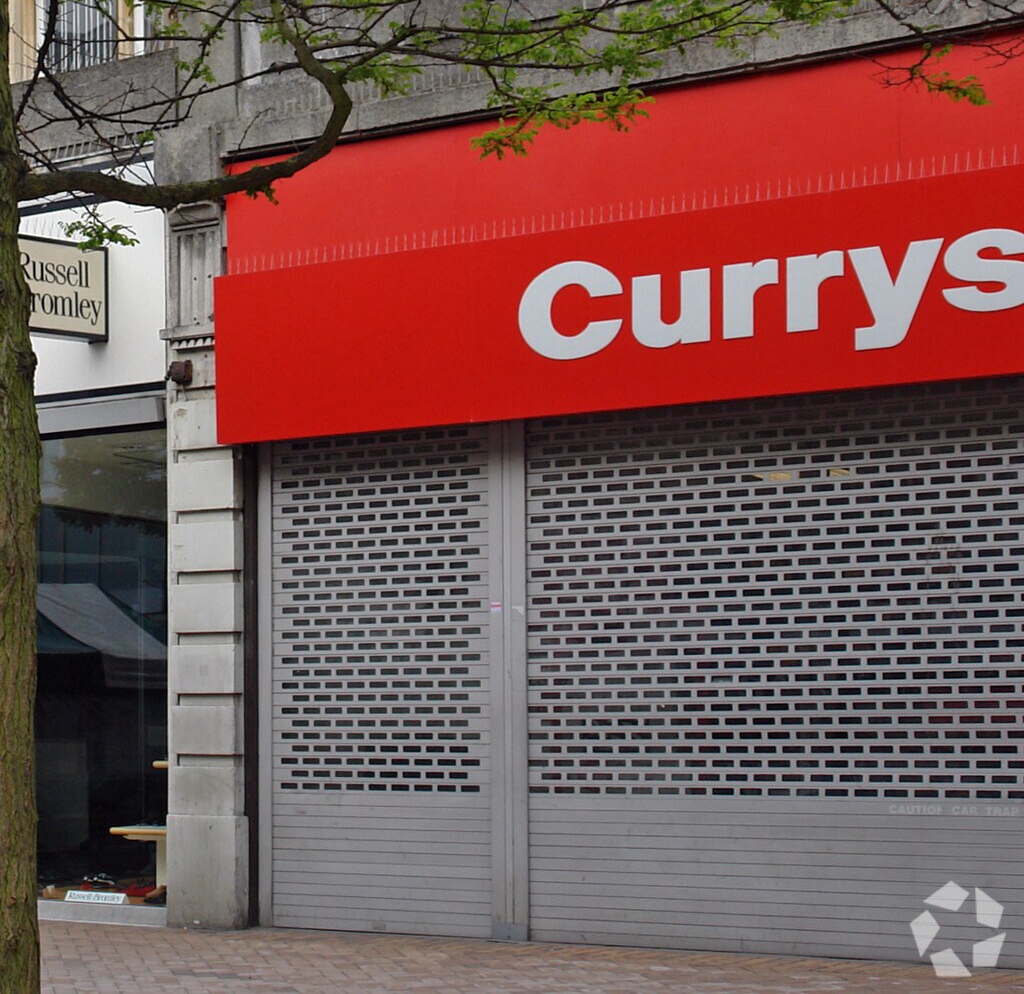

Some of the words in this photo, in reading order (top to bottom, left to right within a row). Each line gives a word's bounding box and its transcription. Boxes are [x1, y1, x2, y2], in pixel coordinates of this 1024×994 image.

[20, 252, 90, 288] Russell
[31, 291, 103, 326] romley
[518, 228, 1024, 360] Currys
[952, 805, 978, 816] CAR
[986, 806, 1019, 817] TRAP
